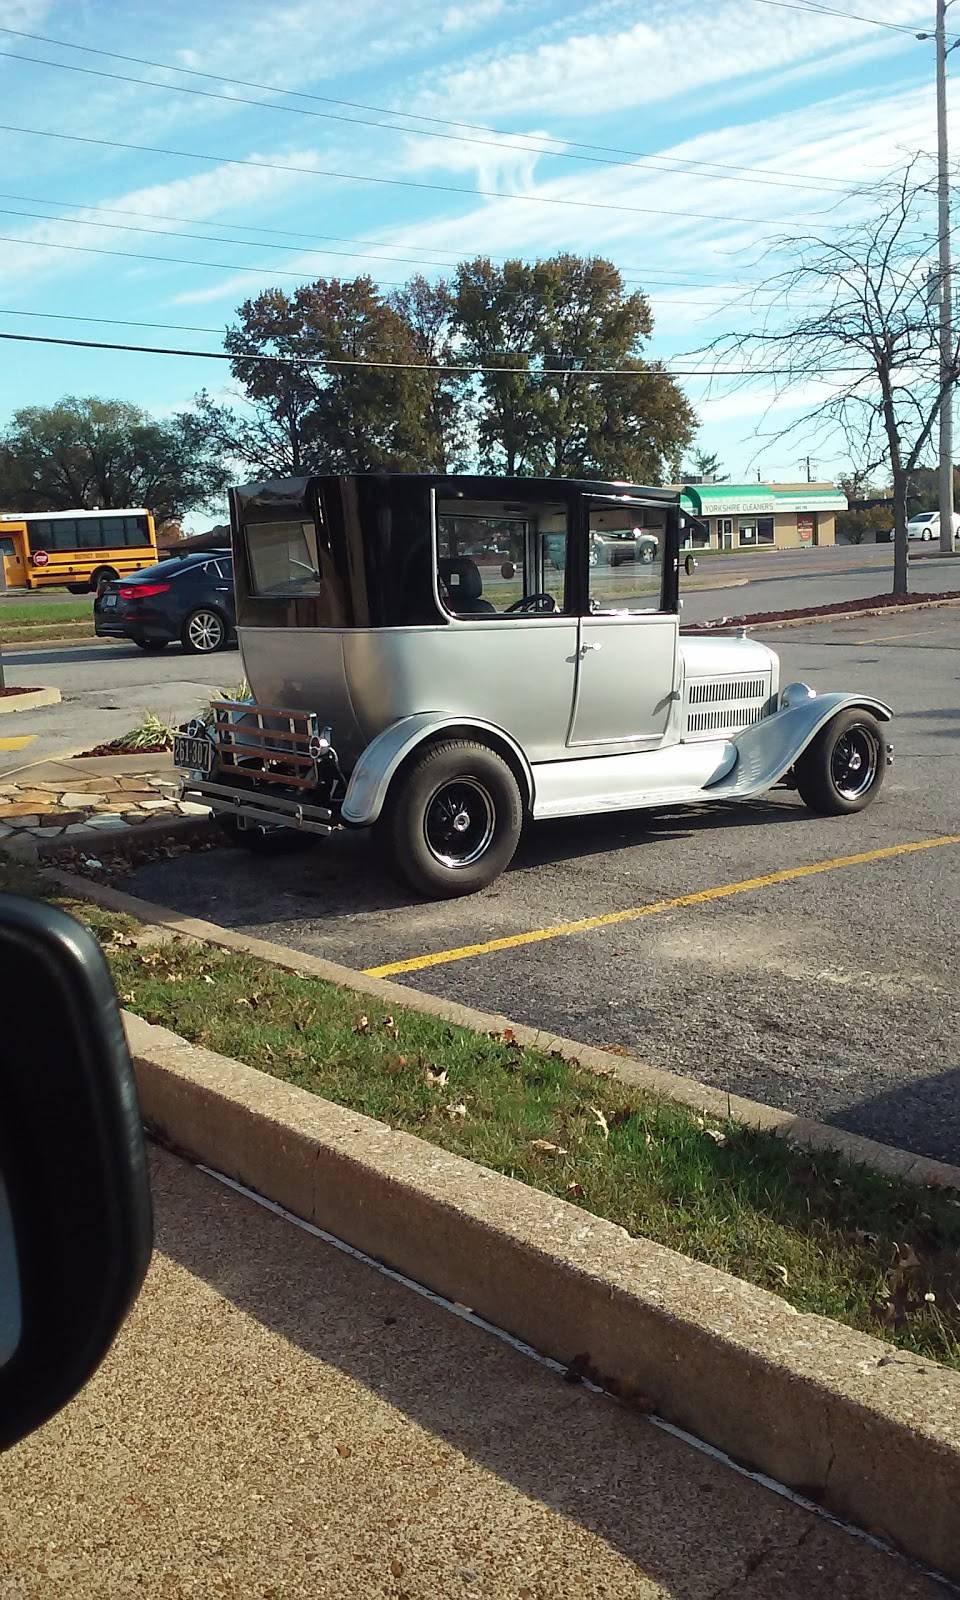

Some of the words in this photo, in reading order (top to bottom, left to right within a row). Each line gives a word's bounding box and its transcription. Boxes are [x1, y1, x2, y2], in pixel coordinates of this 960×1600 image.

[704, 503, 741, 512] YORKSHIRE
[742, 502, 774, 511] CLEANERS
[175, 739, 209, 765] 261-307
